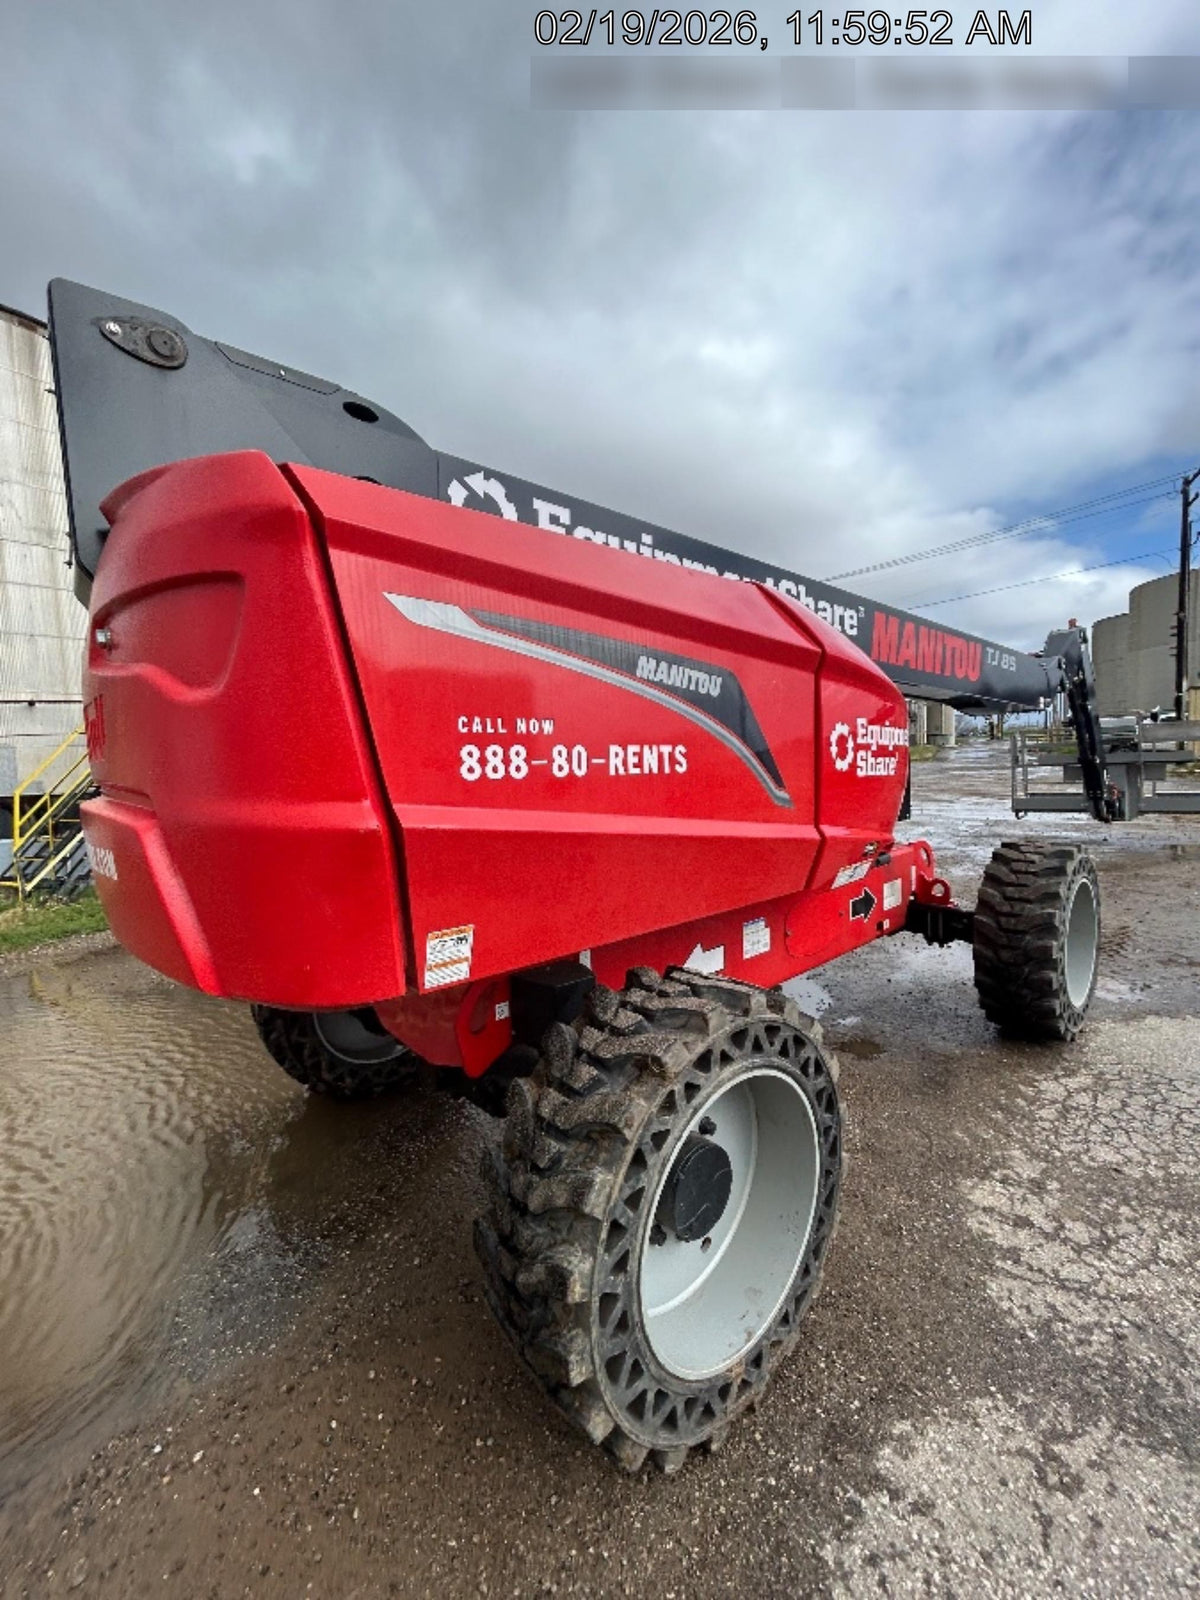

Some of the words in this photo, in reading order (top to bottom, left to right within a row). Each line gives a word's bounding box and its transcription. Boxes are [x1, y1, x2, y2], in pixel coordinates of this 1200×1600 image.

[870, 611, 982, 682] MANITOU
[985, 646, 1000, 667] TJ
[636, 655, 722, 697] MANITOU
[457, 715, 508, 733] CALL
[516, 717, 554, 735] NOW
[459, 744, 688, 782] 888-80-RENTS
[856, 749, 897, 778] Share
